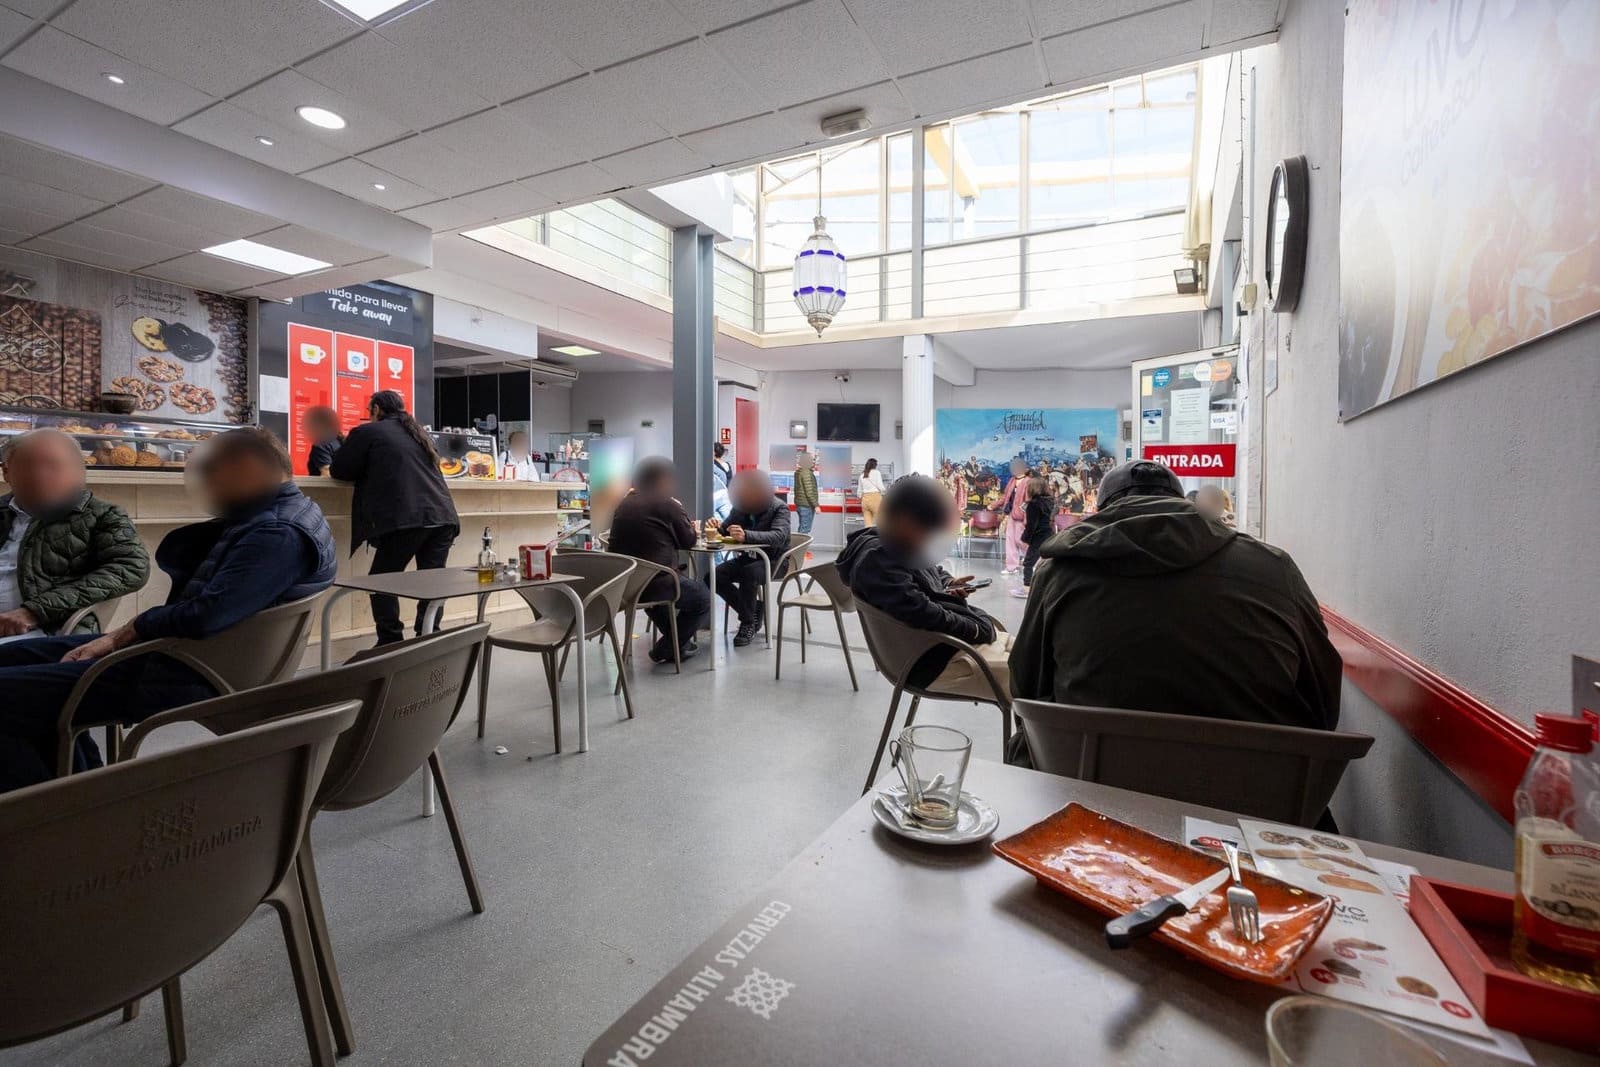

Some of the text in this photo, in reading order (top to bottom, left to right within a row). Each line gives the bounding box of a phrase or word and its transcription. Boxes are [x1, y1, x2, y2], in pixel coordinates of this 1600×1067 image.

[325, 287, 408, 313] mida para llevar
[328, 297, 393, 326] Take away
[1152, 454, 1224, 468] ENTRADA
[606, 900, 792, 1067] CERVEZAS ALHAMBRA
